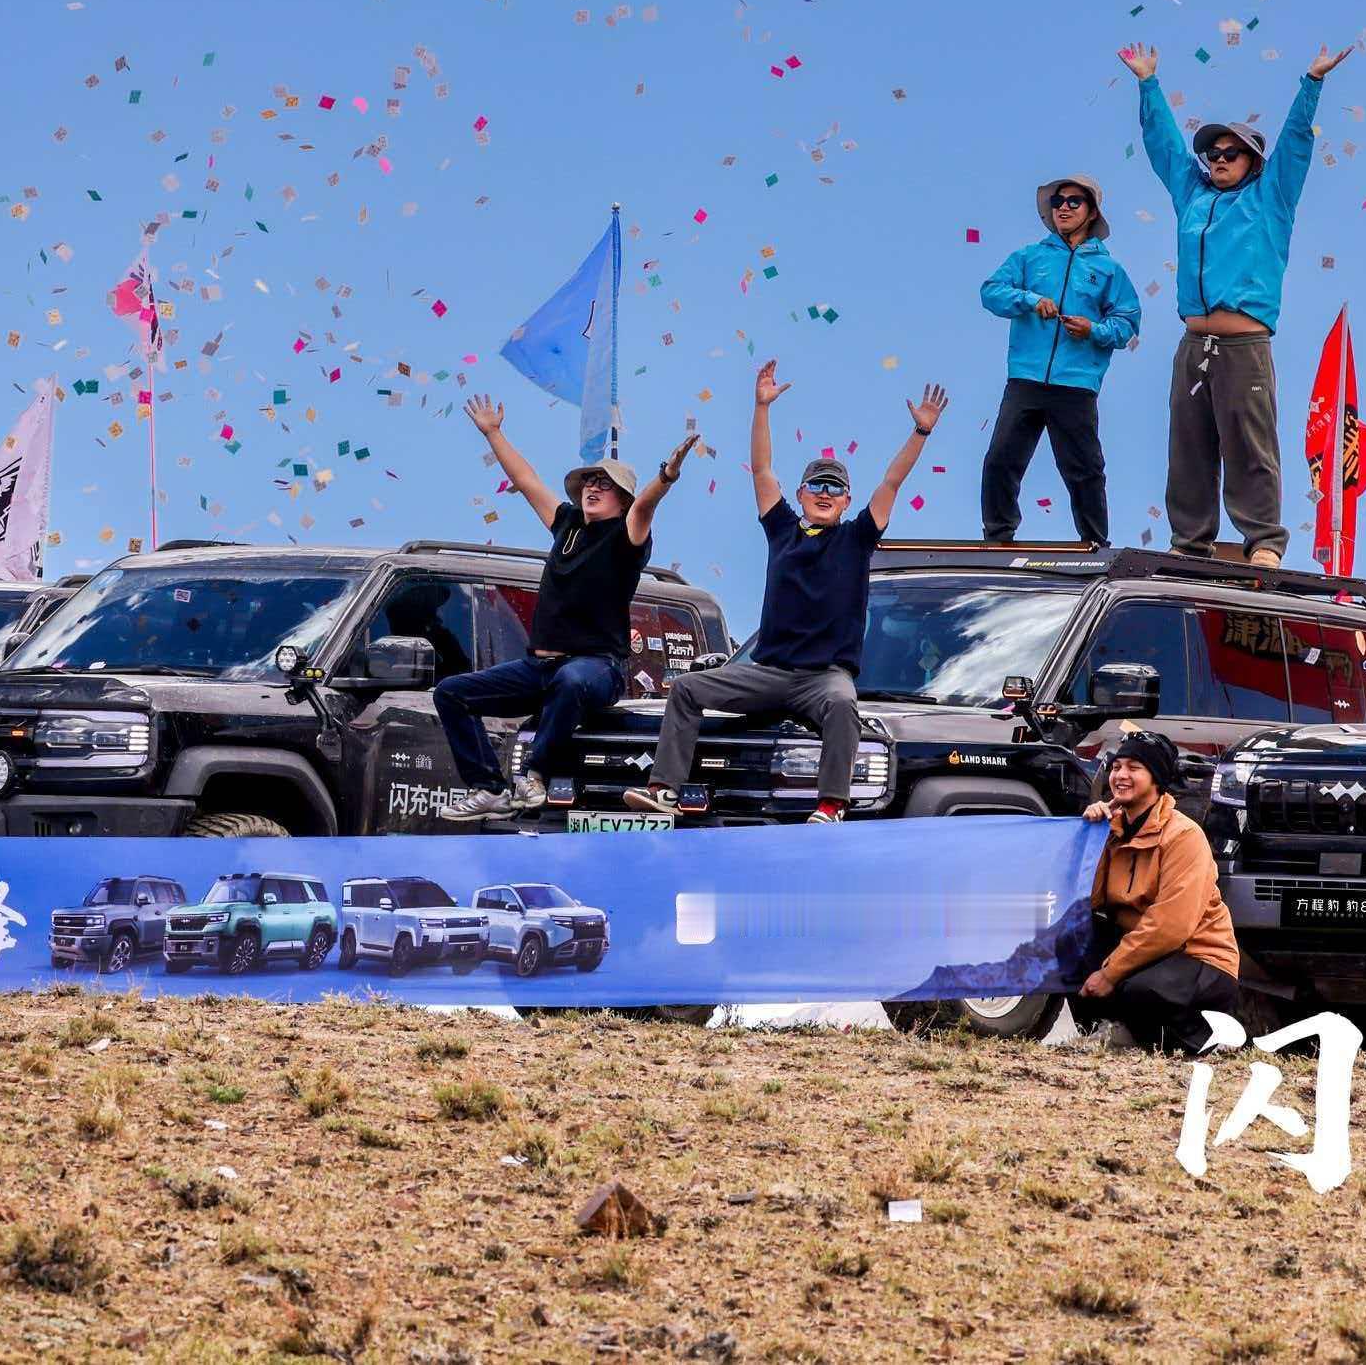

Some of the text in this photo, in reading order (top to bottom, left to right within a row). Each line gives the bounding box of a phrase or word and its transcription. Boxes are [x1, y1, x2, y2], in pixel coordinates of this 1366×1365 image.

[959, 754, 1008, 767] LAND SHARK
[1296, 898, 1340, 913] 方程豹
